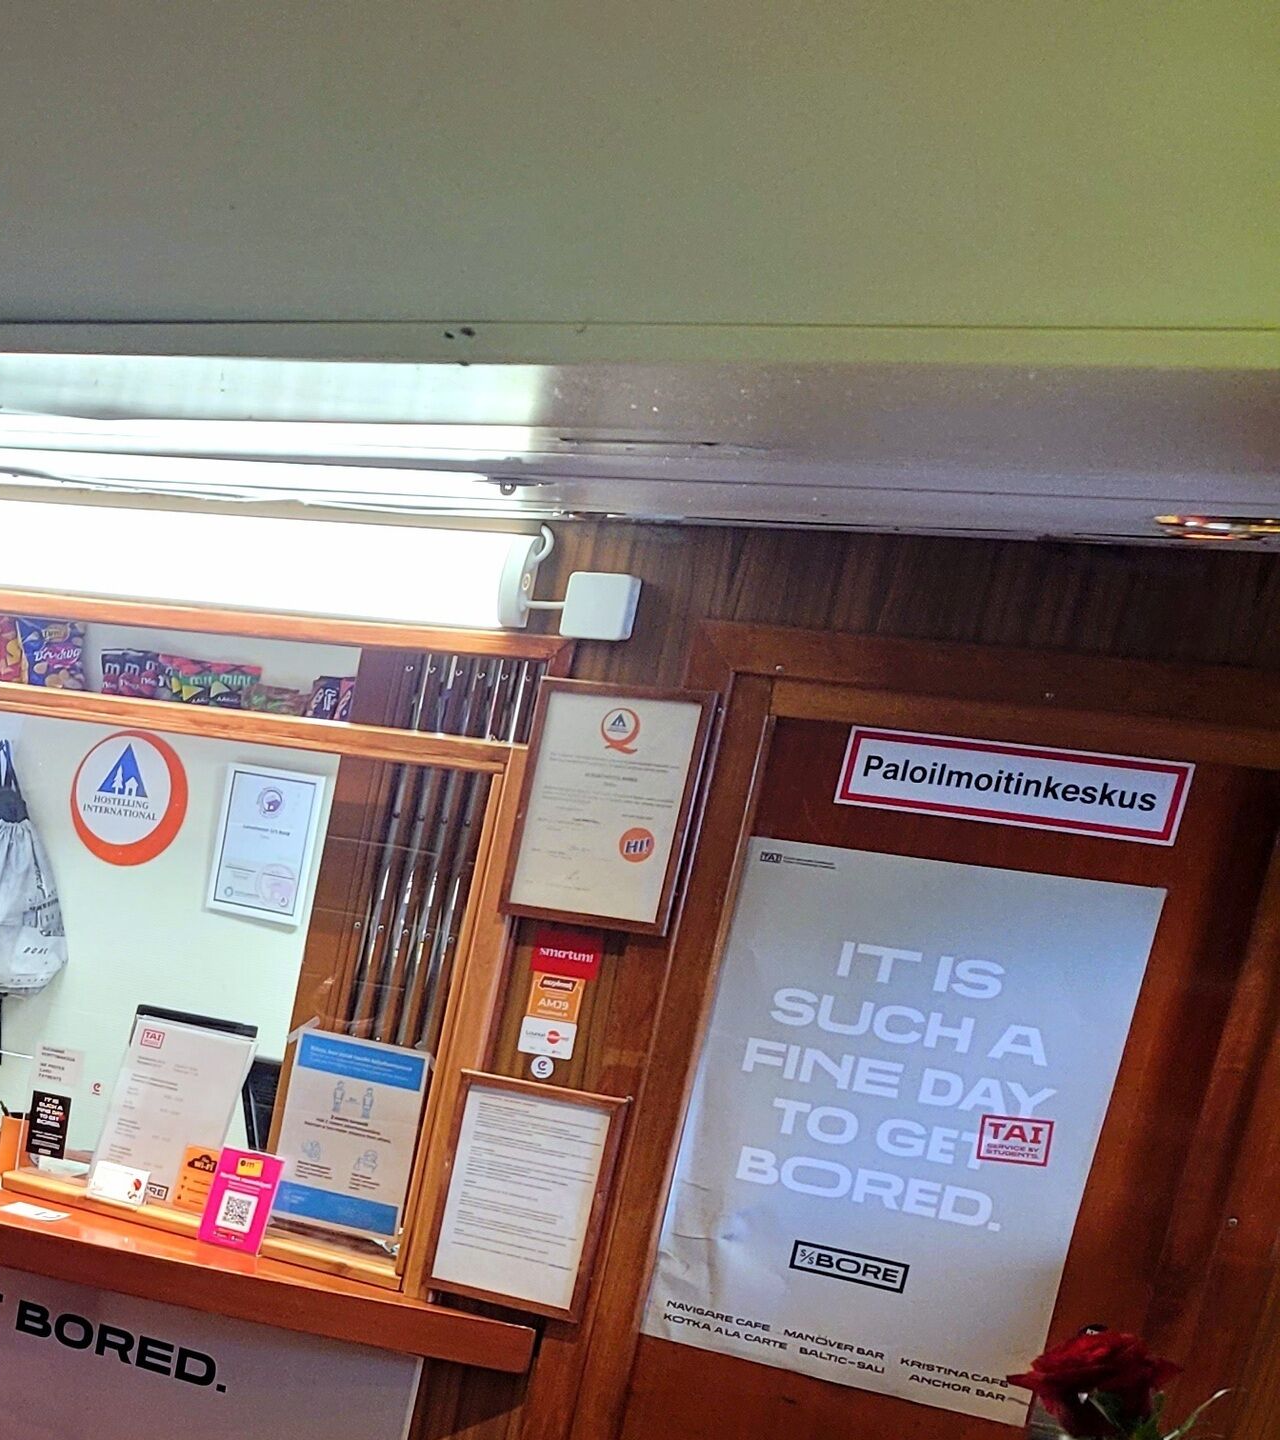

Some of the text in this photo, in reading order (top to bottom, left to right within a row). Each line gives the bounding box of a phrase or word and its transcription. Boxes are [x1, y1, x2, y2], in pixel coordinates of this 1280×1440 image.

[862, 754, 1158, 812] Paloilmoitinkeskus
[82, 803, 158, 822] INTERNATIONAL
[93, 794, 150, 811] HOSTELLING
[624, 838, 651, 854] HI!
[836, 940, 1006, 1000] IT IS
[145, 1031, 162, 1042] TAI
[769, 986, 1048, 1068] SUCH A
[741, 1036, 1058, 1116] FINE DAY
[772, 1096, 860, 1146] TO
[988, 1122, 1044, 1145] TAI
[986, 1143, 1026, 1152] SERVICE
[734, 1144, 1002, 1233] BORED.
[815, 1252, 900, 1284] BORE
[663, 1312, 712, 1332] KOTKA
[743, 1332, 789, 1351] CARTE
[666, 1299, 771, 1333] NAVIGARE CAFE
[14, 1299, 228, 1394] BORED.
[856, 1346, 886, 1361] BAR
[900, 1356, 970, 1381] KRISTINA
[908, 1373, 1007, 1402] ANCHOR BAR
